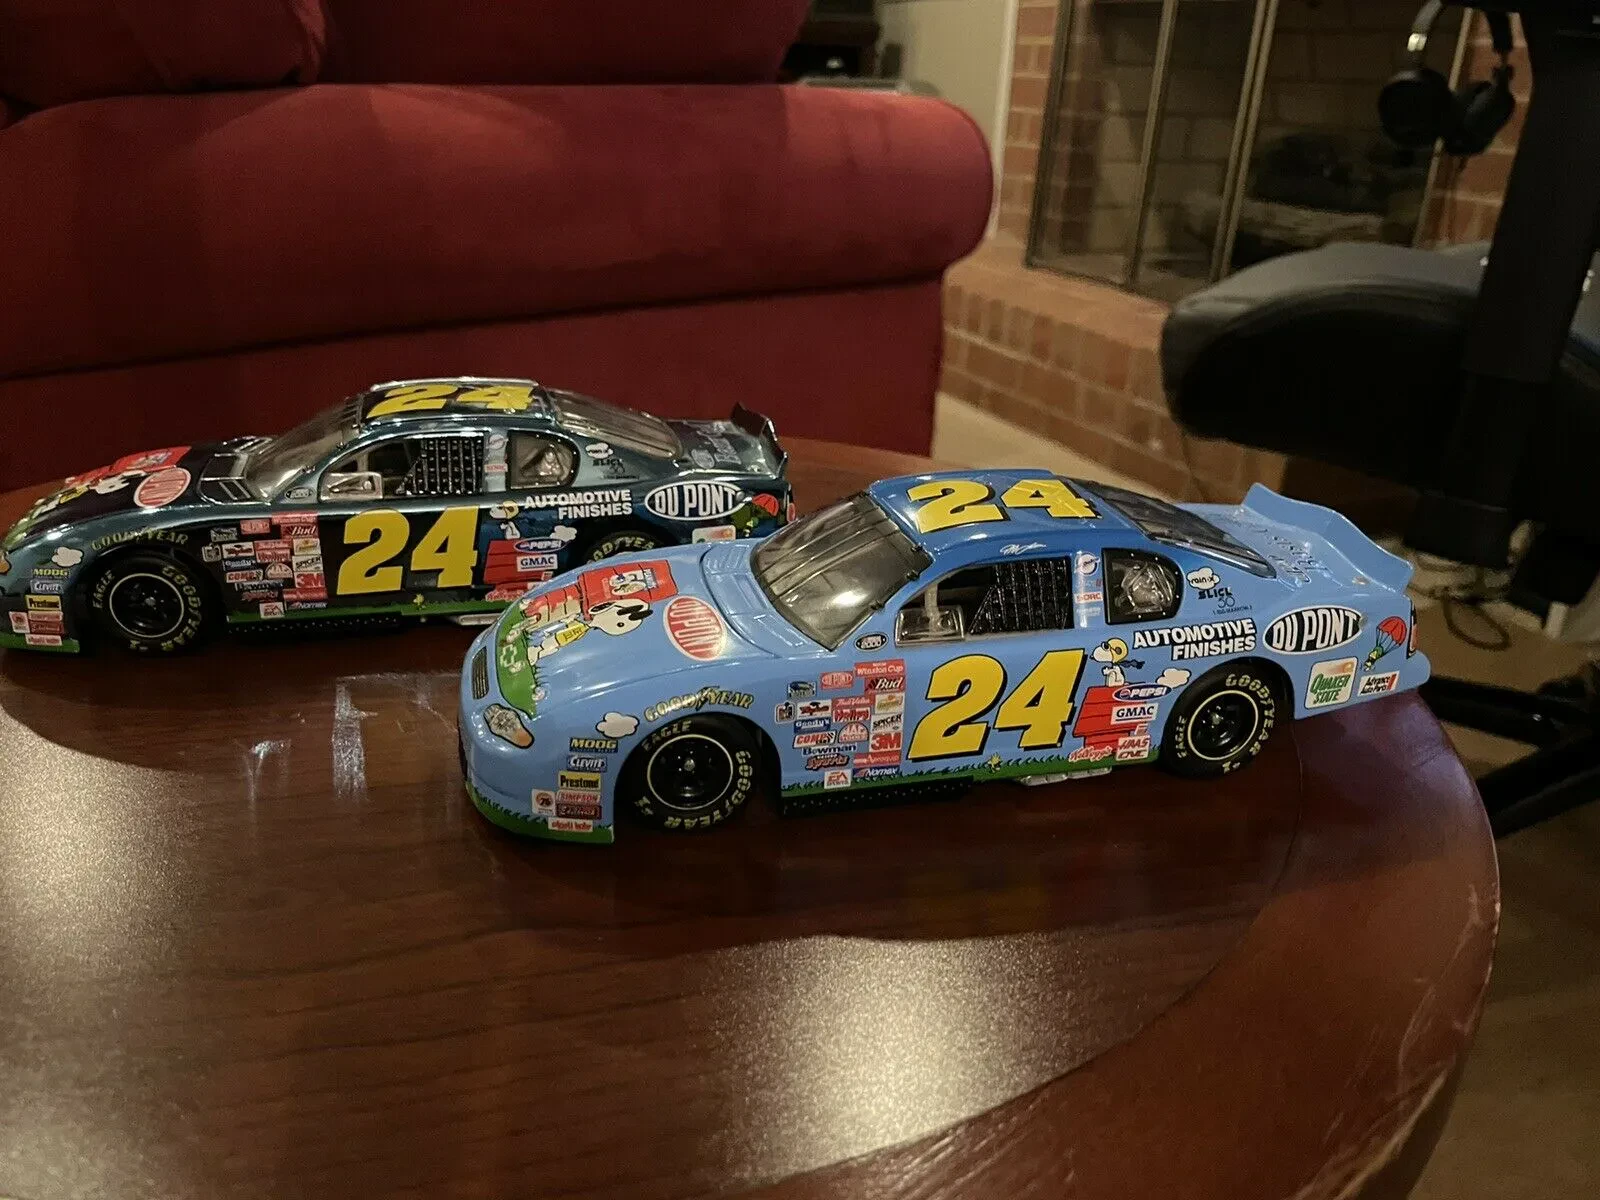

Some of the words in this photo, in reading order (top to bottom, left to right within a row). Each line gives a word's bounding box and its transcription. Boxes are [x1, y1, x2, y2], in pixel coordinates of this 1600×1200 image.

[366, 384, 534, 419] 24
[524, 489, 632, 510] AUTOMOTIVE
[907, 479, 1098, 534] 24
[558, 502, 633, 520] FINISHES
[336, 505, 480, 596] 24
[529, 540, 562, 550] PEPSI
[520, 555, 556, 567] GMAC
[1133, 618, 1256, 649] AUTOMOTIVE
[1172, 635, 1257, 661] FINISHES
[875, 677, 904, 690] Bud
[1130, 686, 1168, 698] PEPSI
[1310, 672, 1351, 697] QUAKER
[644, 685, 754, 722] GOODYEAR
[908, 649, 1087, 762] 24
[1116, 706, 1155, 718] GMAC
[873, 714, 902, 728] SPICER
[570, 739, 618, 749] MOOG
[642, 720, 692, 750] EAGLE
[871, 732, 902, 750] 3M
[560, 774, 600, 789] Prestone
